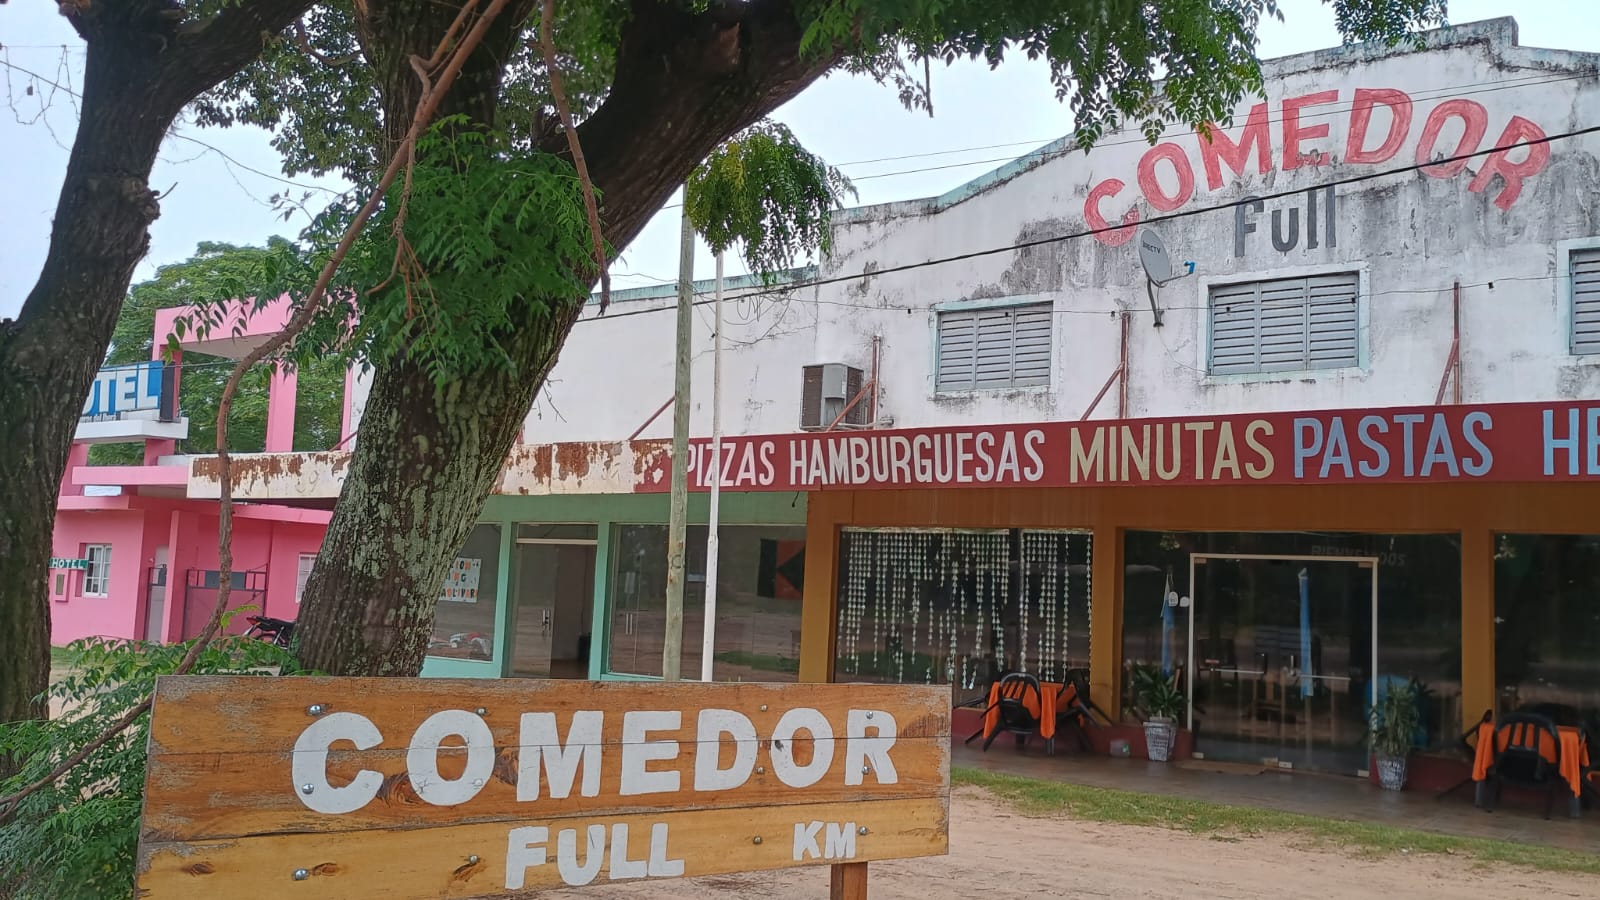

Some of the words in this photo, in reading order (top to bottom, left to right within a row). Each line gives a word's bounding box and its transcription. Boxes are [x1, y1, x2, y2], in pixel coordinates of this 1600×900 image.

[1084, 88, 1550, 247] COMEDOR
[82, 364, 159, 415] TEL
[686, 440, 775, 487] PIZZAS
[790, 429, 1045, 486] HAMBURGUESAS
[1070, 420, 1275, 483] MINUTAS
[1294, 412, 1492, 478] PASTAS
[51, 558, 84, 569] HOTEL
[291, 707, 897, 815] COMEDOR
[505, 823, 685, 891] FULL
[793, 821, 857, 861] KM
